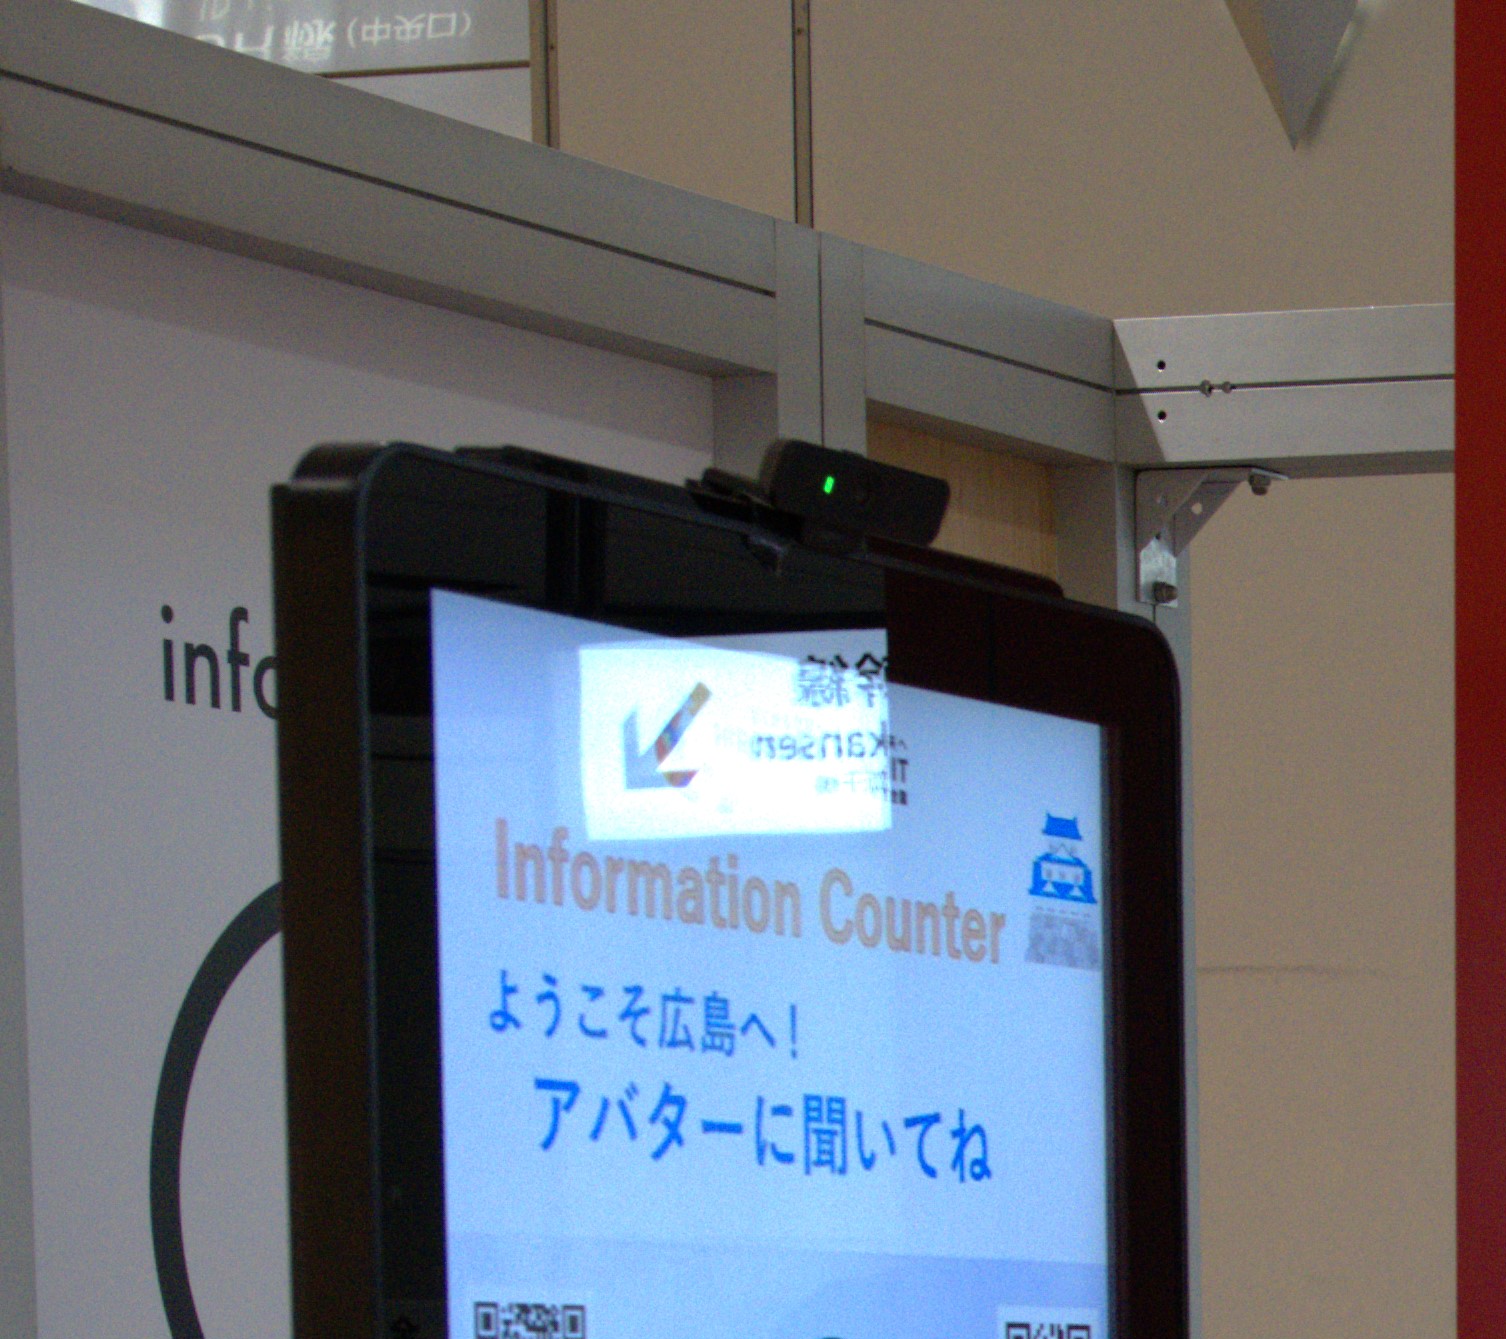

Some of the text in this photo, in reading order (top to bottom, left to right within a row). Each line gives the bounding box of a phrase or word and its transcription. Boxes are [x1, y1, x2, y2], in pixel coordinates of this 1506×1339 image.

[494, 818, 1006, 964] Information Counter
[534, 1076, 992, 1183] アバターに聞いてね
